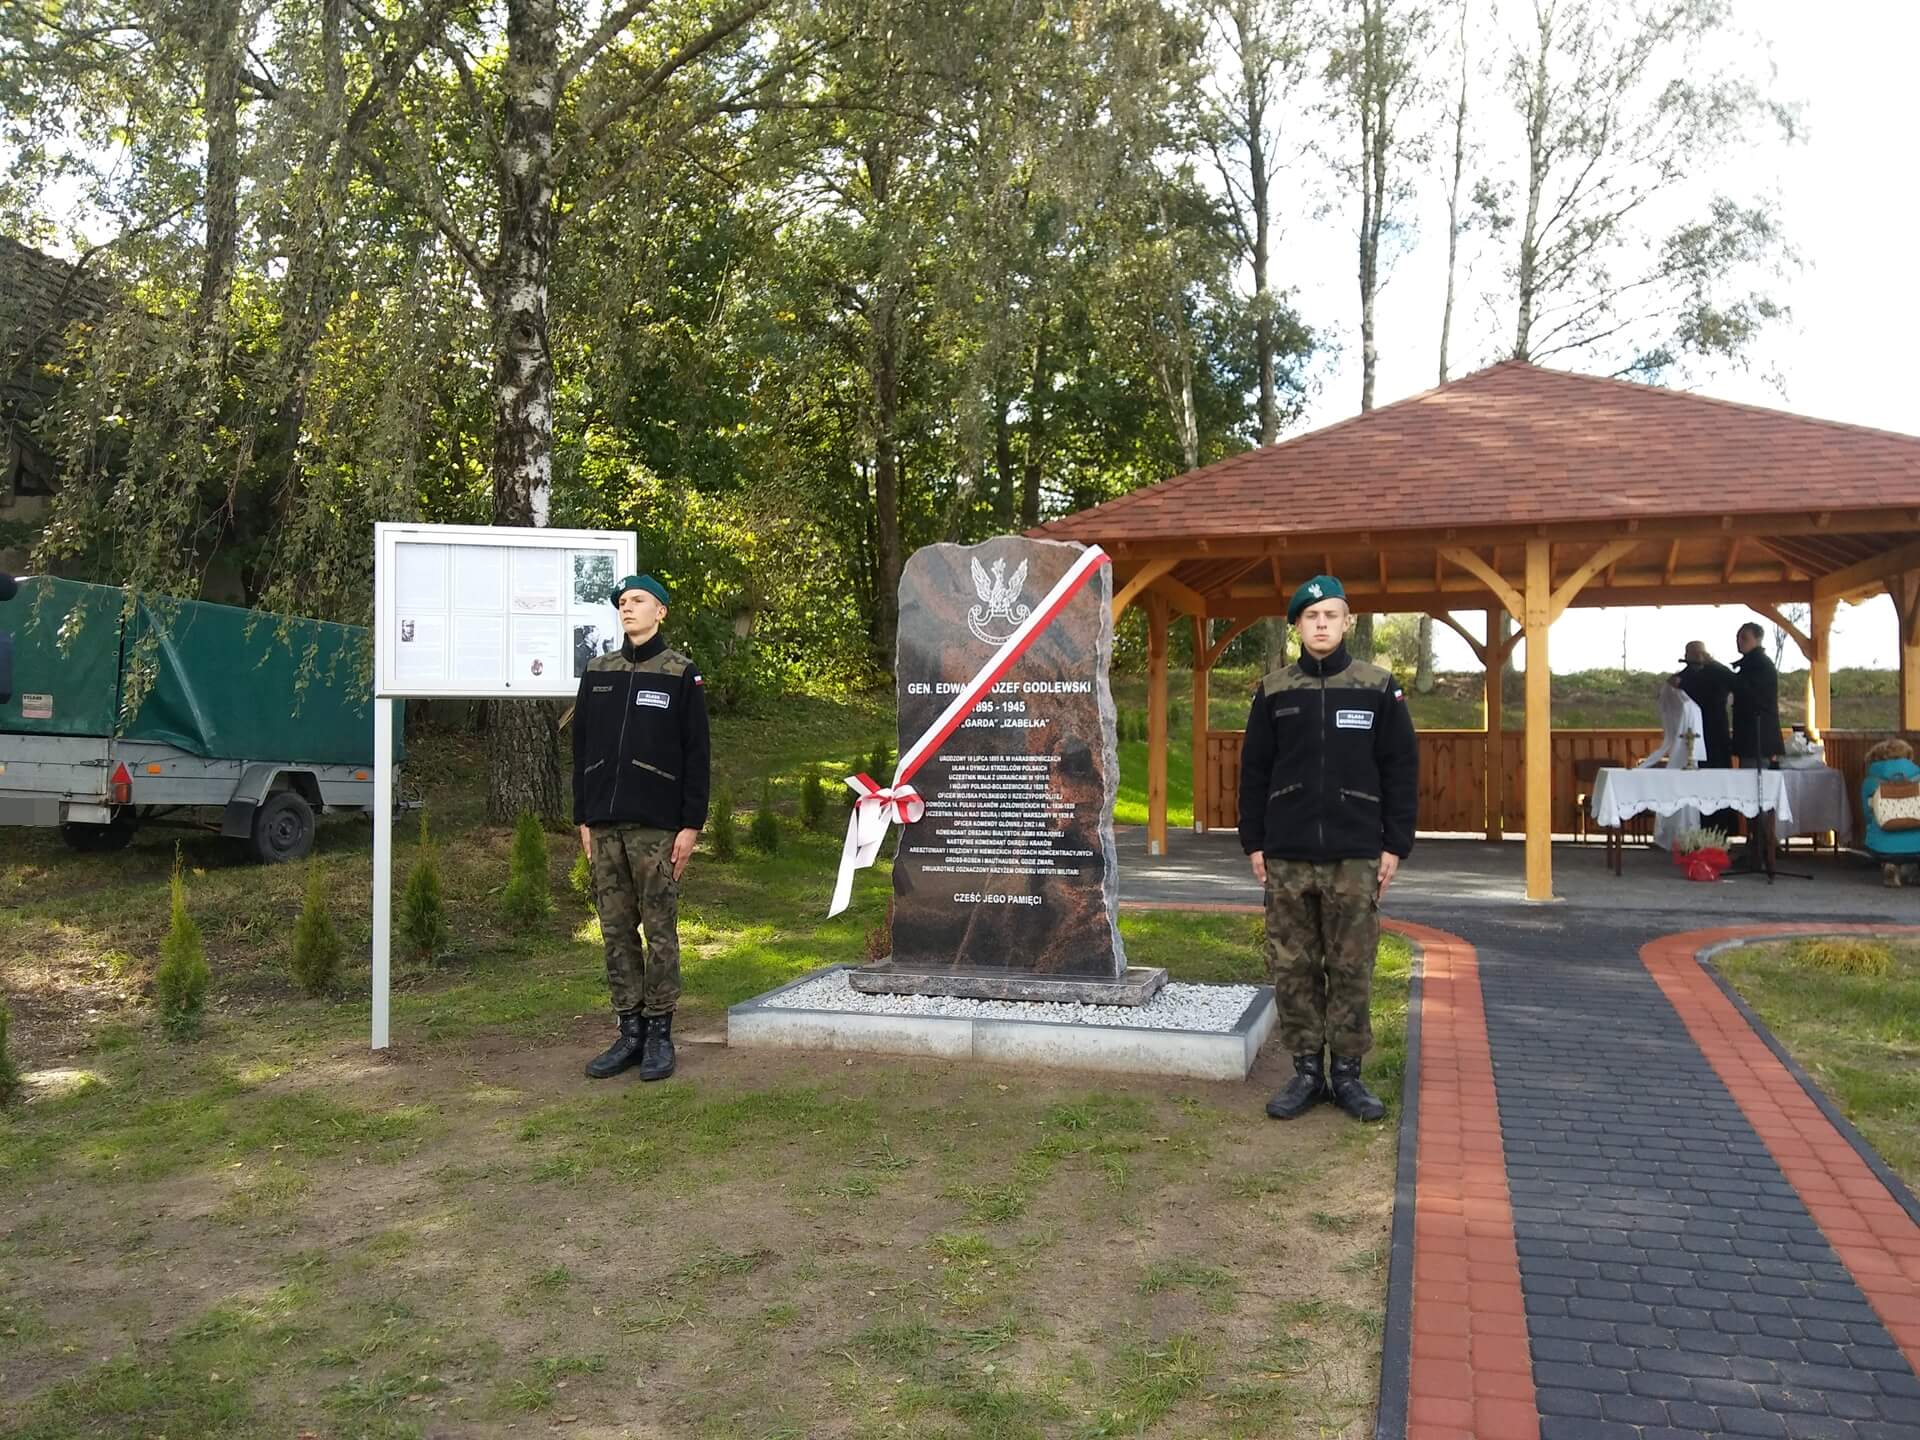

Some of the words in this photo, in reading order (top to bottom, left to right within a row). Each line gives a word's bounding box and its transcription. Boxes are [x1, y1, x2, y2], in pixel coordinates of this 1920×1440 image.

[908, 682, 933, 694] GEN.
[935, 682, 969, 694] EDWA
[989, 681, 1020, 694] OZEF
[1023, 681, 1091, 693] GODLEWSKI
[1002, 701, 1026, 713] 1945
[953, 891, 981, 903] CZEŚĆ
[982, 894, 1006, 904] JEGO
[1007, 895, 1042, 906] PAMIĘCI
